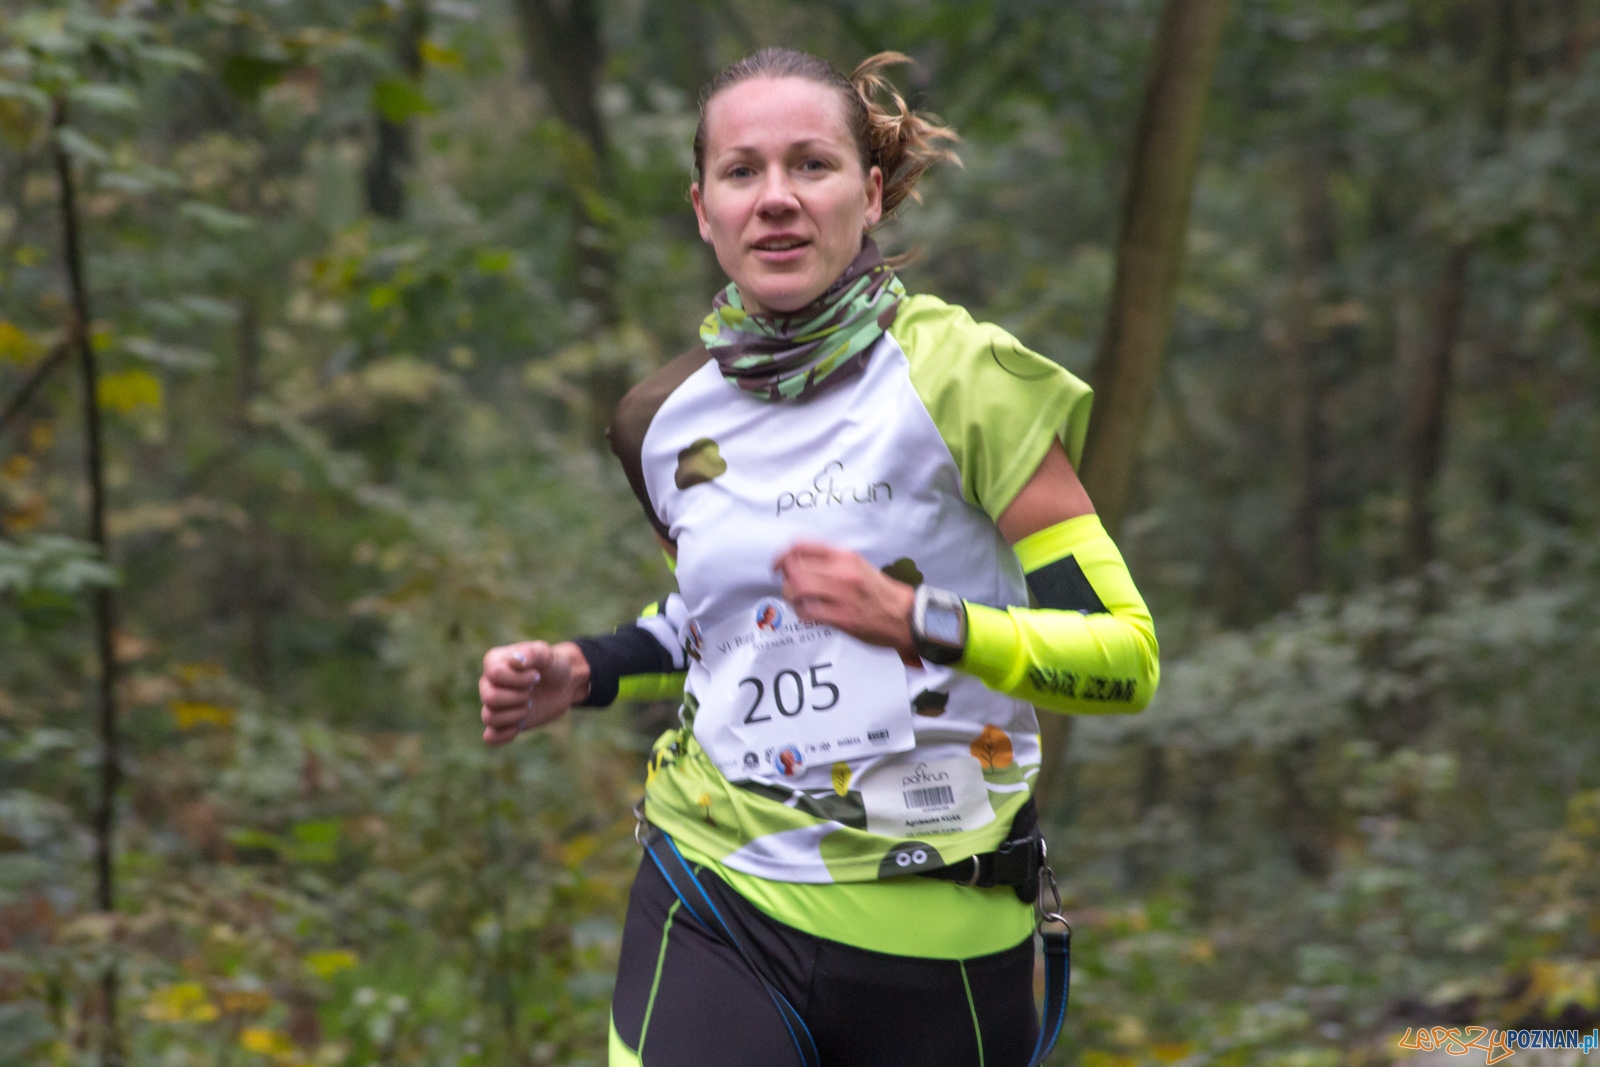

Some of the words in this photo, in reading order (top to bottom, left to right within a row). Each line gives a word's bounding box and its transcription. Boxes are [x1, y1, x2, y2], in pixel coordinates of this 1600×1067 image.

[776, 461, 893, 517] parkrun
[738, 661, 840, 725] 205
[902, 763, 950, 787] parkrun
